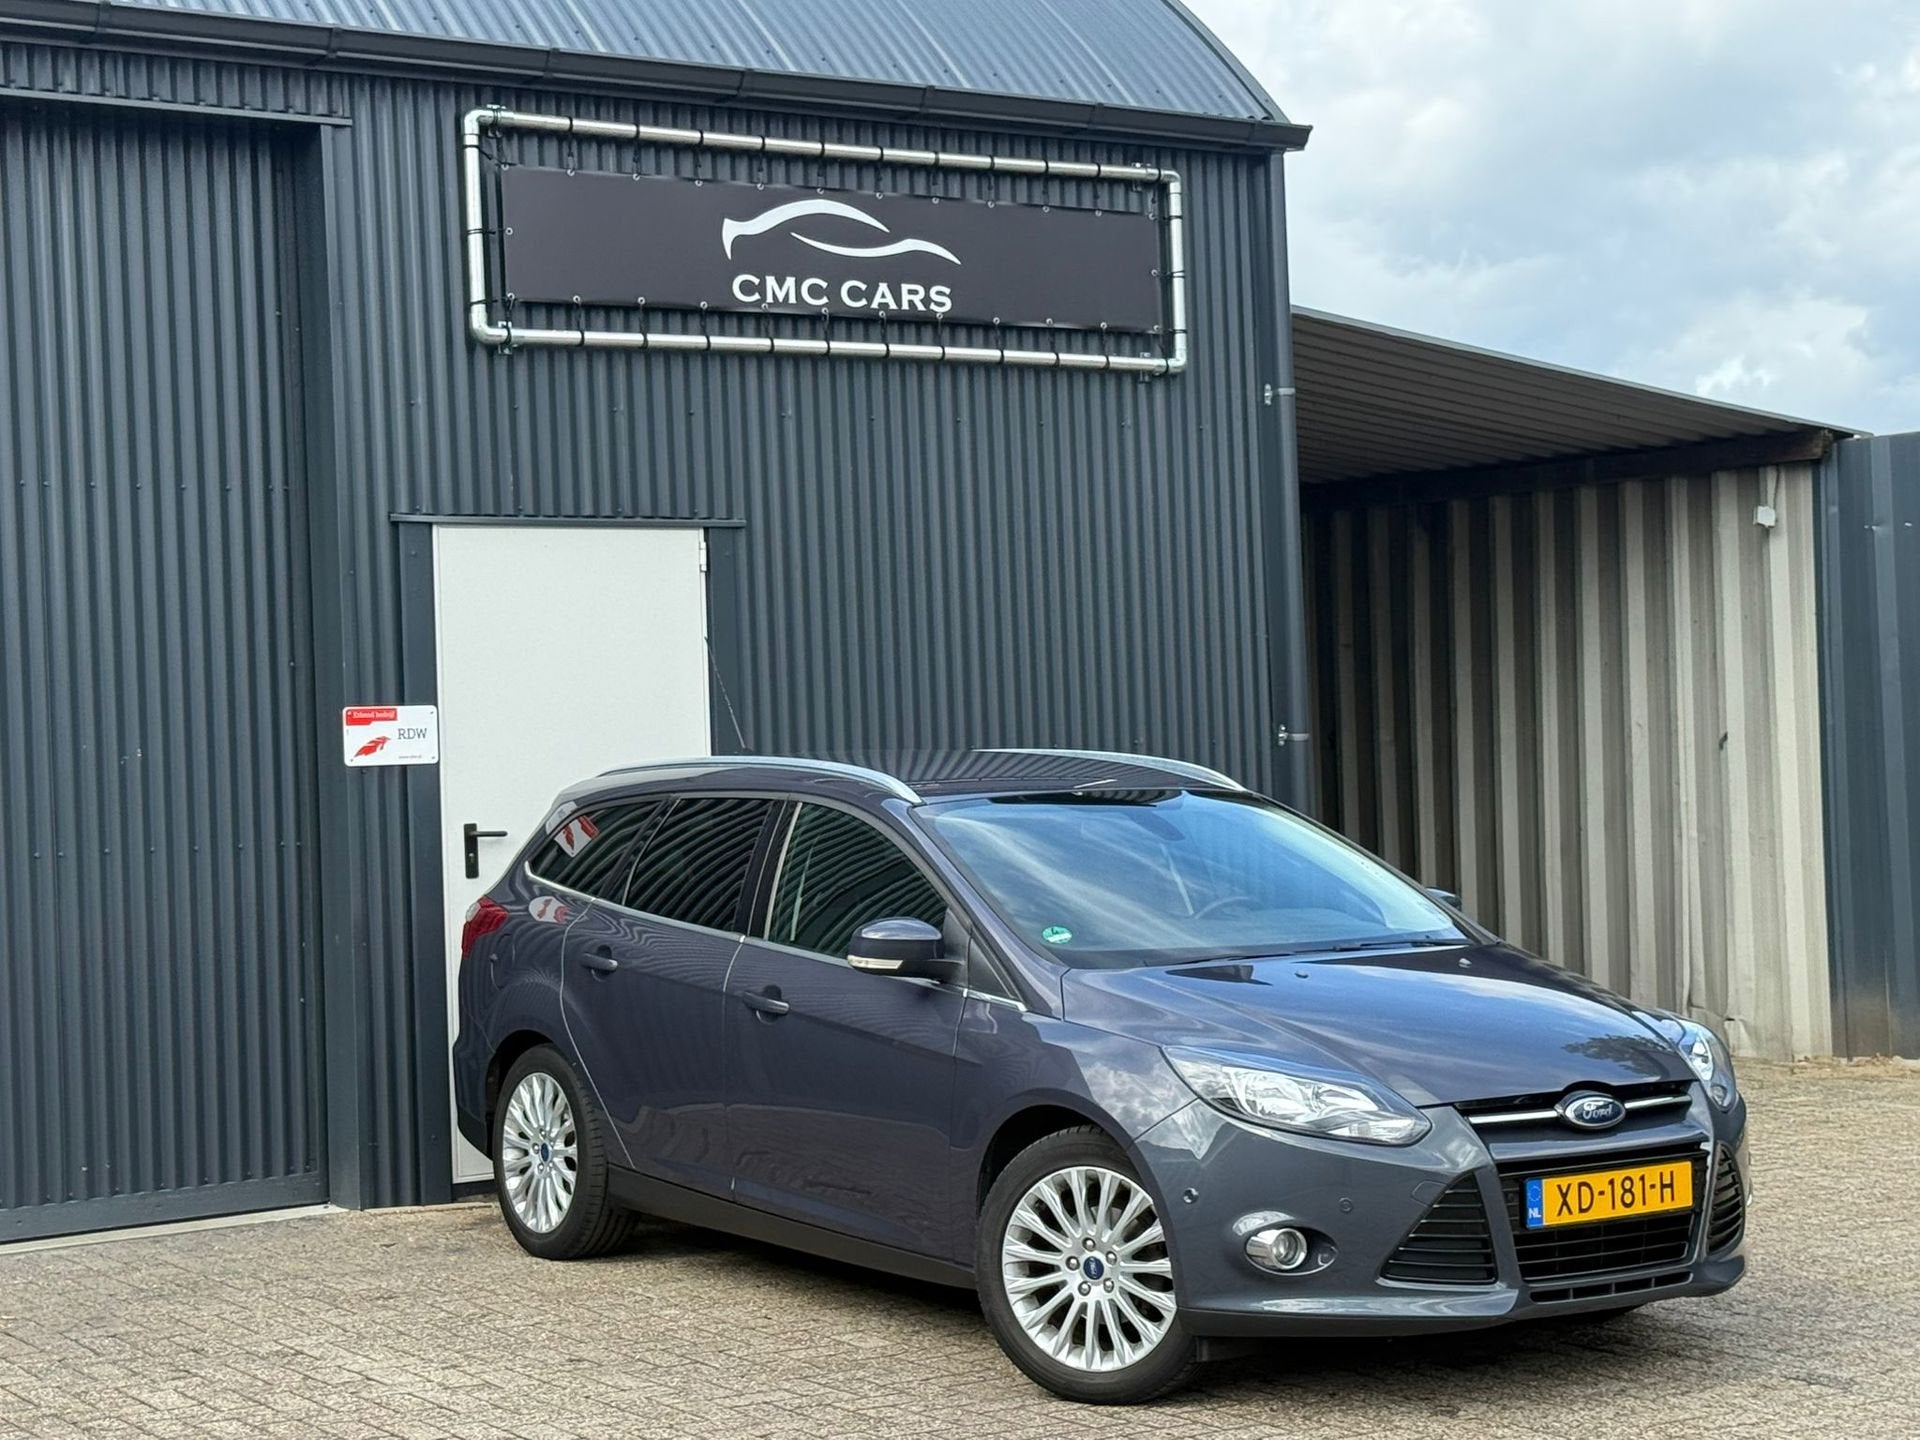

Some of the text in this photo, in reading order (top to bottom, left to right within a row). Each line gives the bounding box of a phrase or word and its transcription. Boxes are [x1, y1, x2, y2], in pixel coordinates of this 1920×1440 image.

[732, 274, 952, 313] CMC CARS
[397, 727, 428, 740] RDW
[1583, 1101, 1613, 1120] Ford
[1556, 1170, 1676, 1217] XD-181-H
[1528, 1207, 1542, 1219] NL
